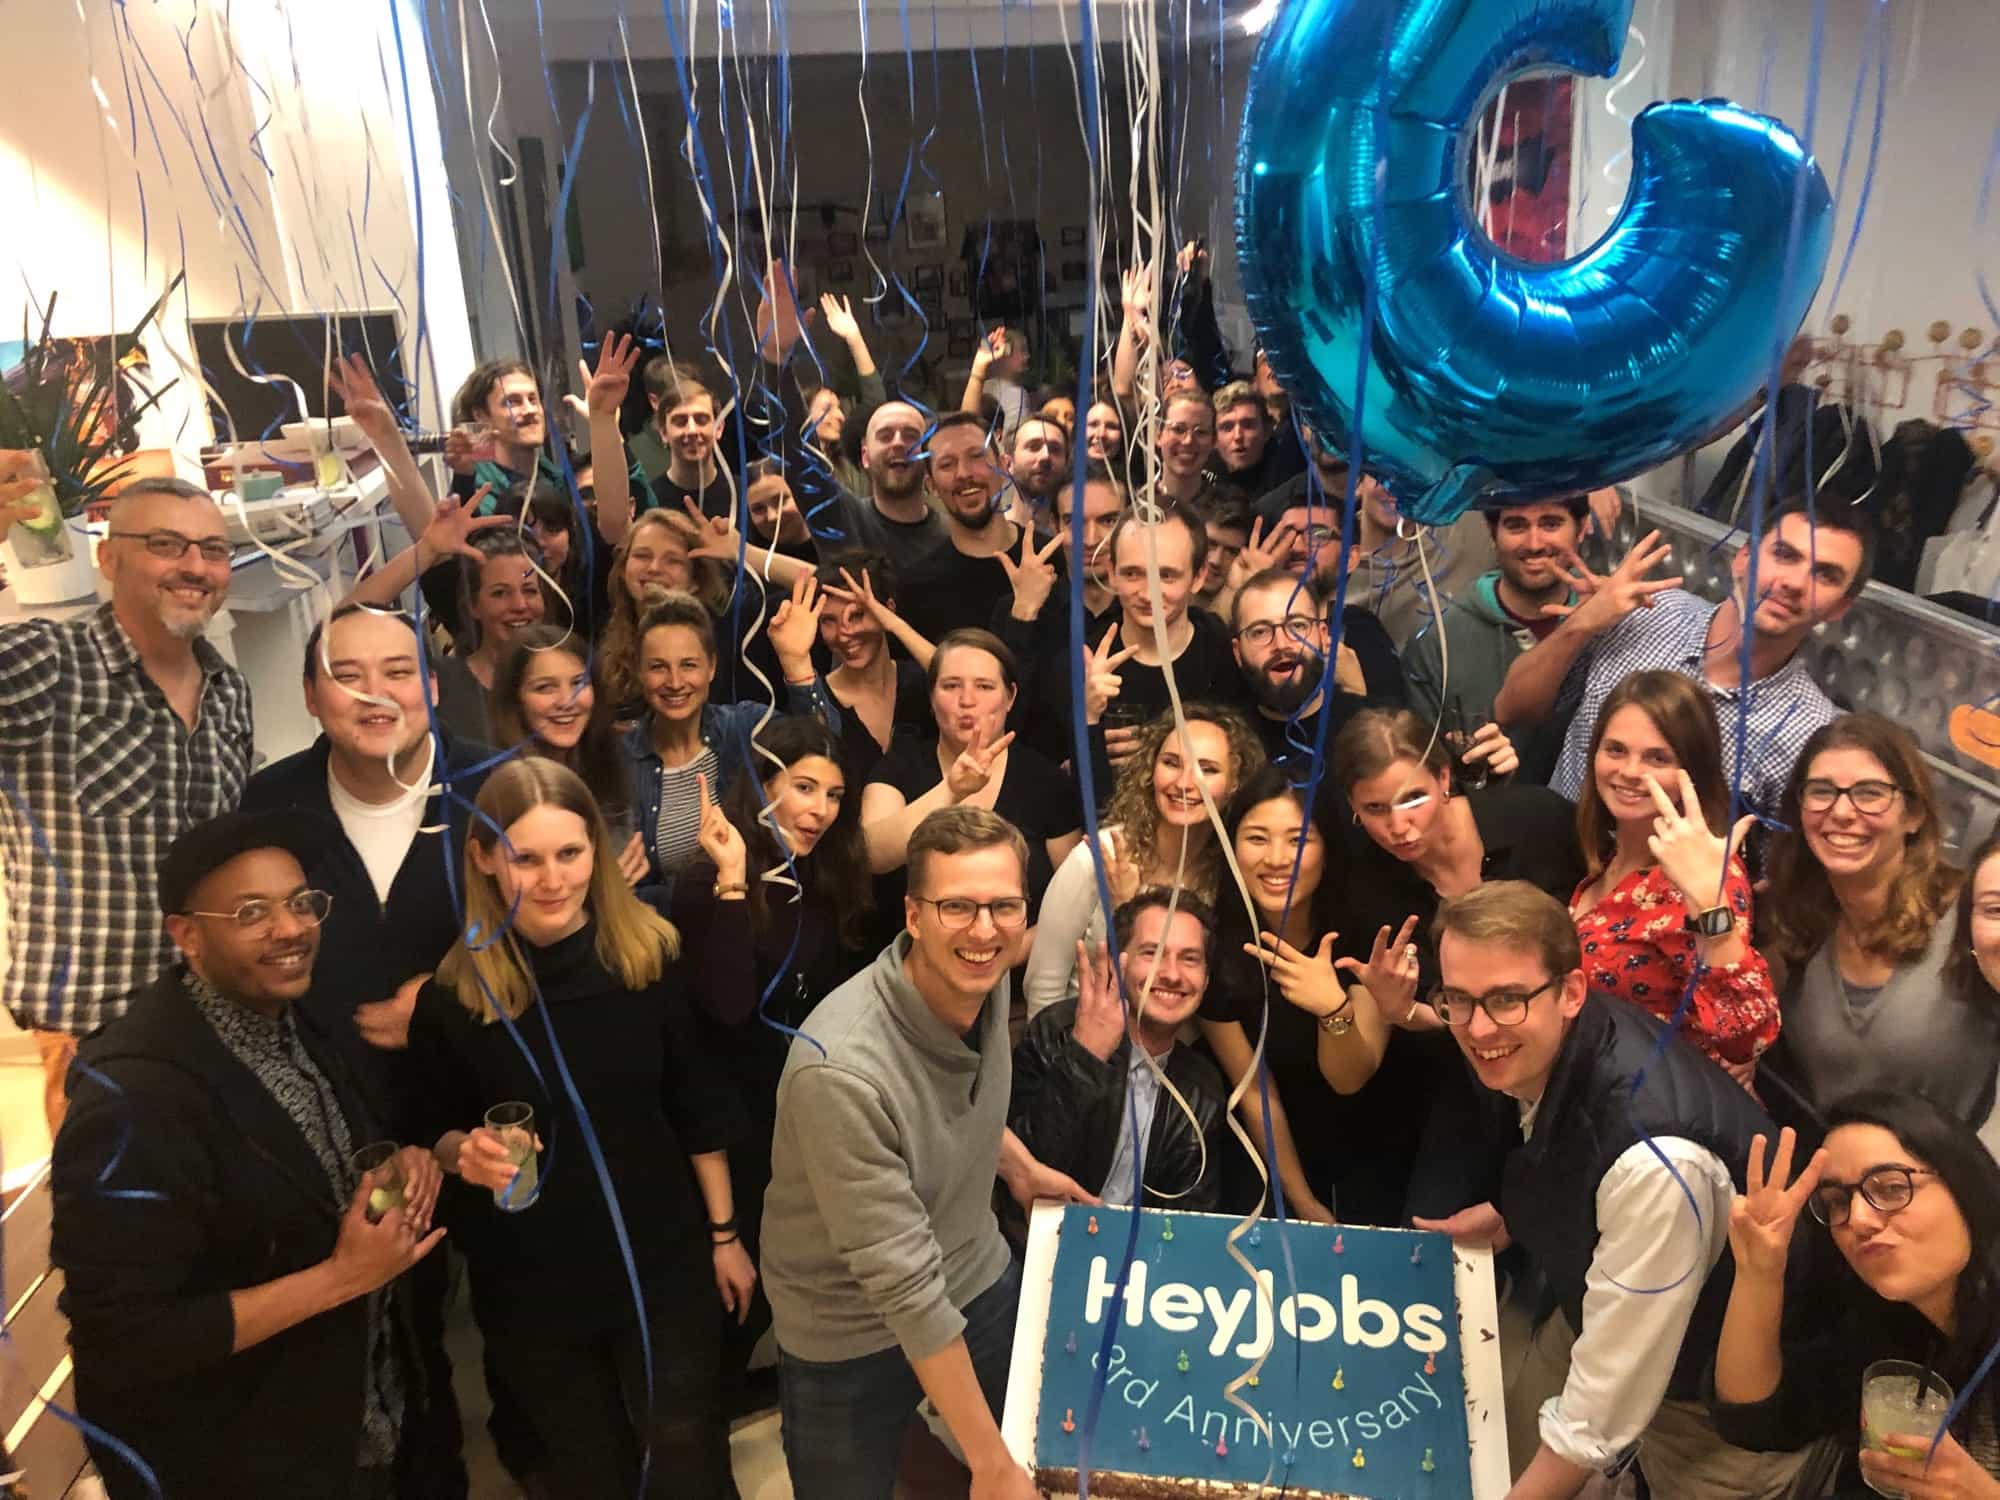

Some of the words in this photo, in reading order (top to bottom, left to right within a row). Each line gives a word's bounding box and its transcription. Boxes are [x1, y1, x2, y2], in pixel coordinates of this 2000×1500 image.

[1085, 1255, 1448, 1359] HeyJobs
[1091, 1344, 1160, 1408] 3rd
[1164, 1371, 1442, 1449] Anniversary
